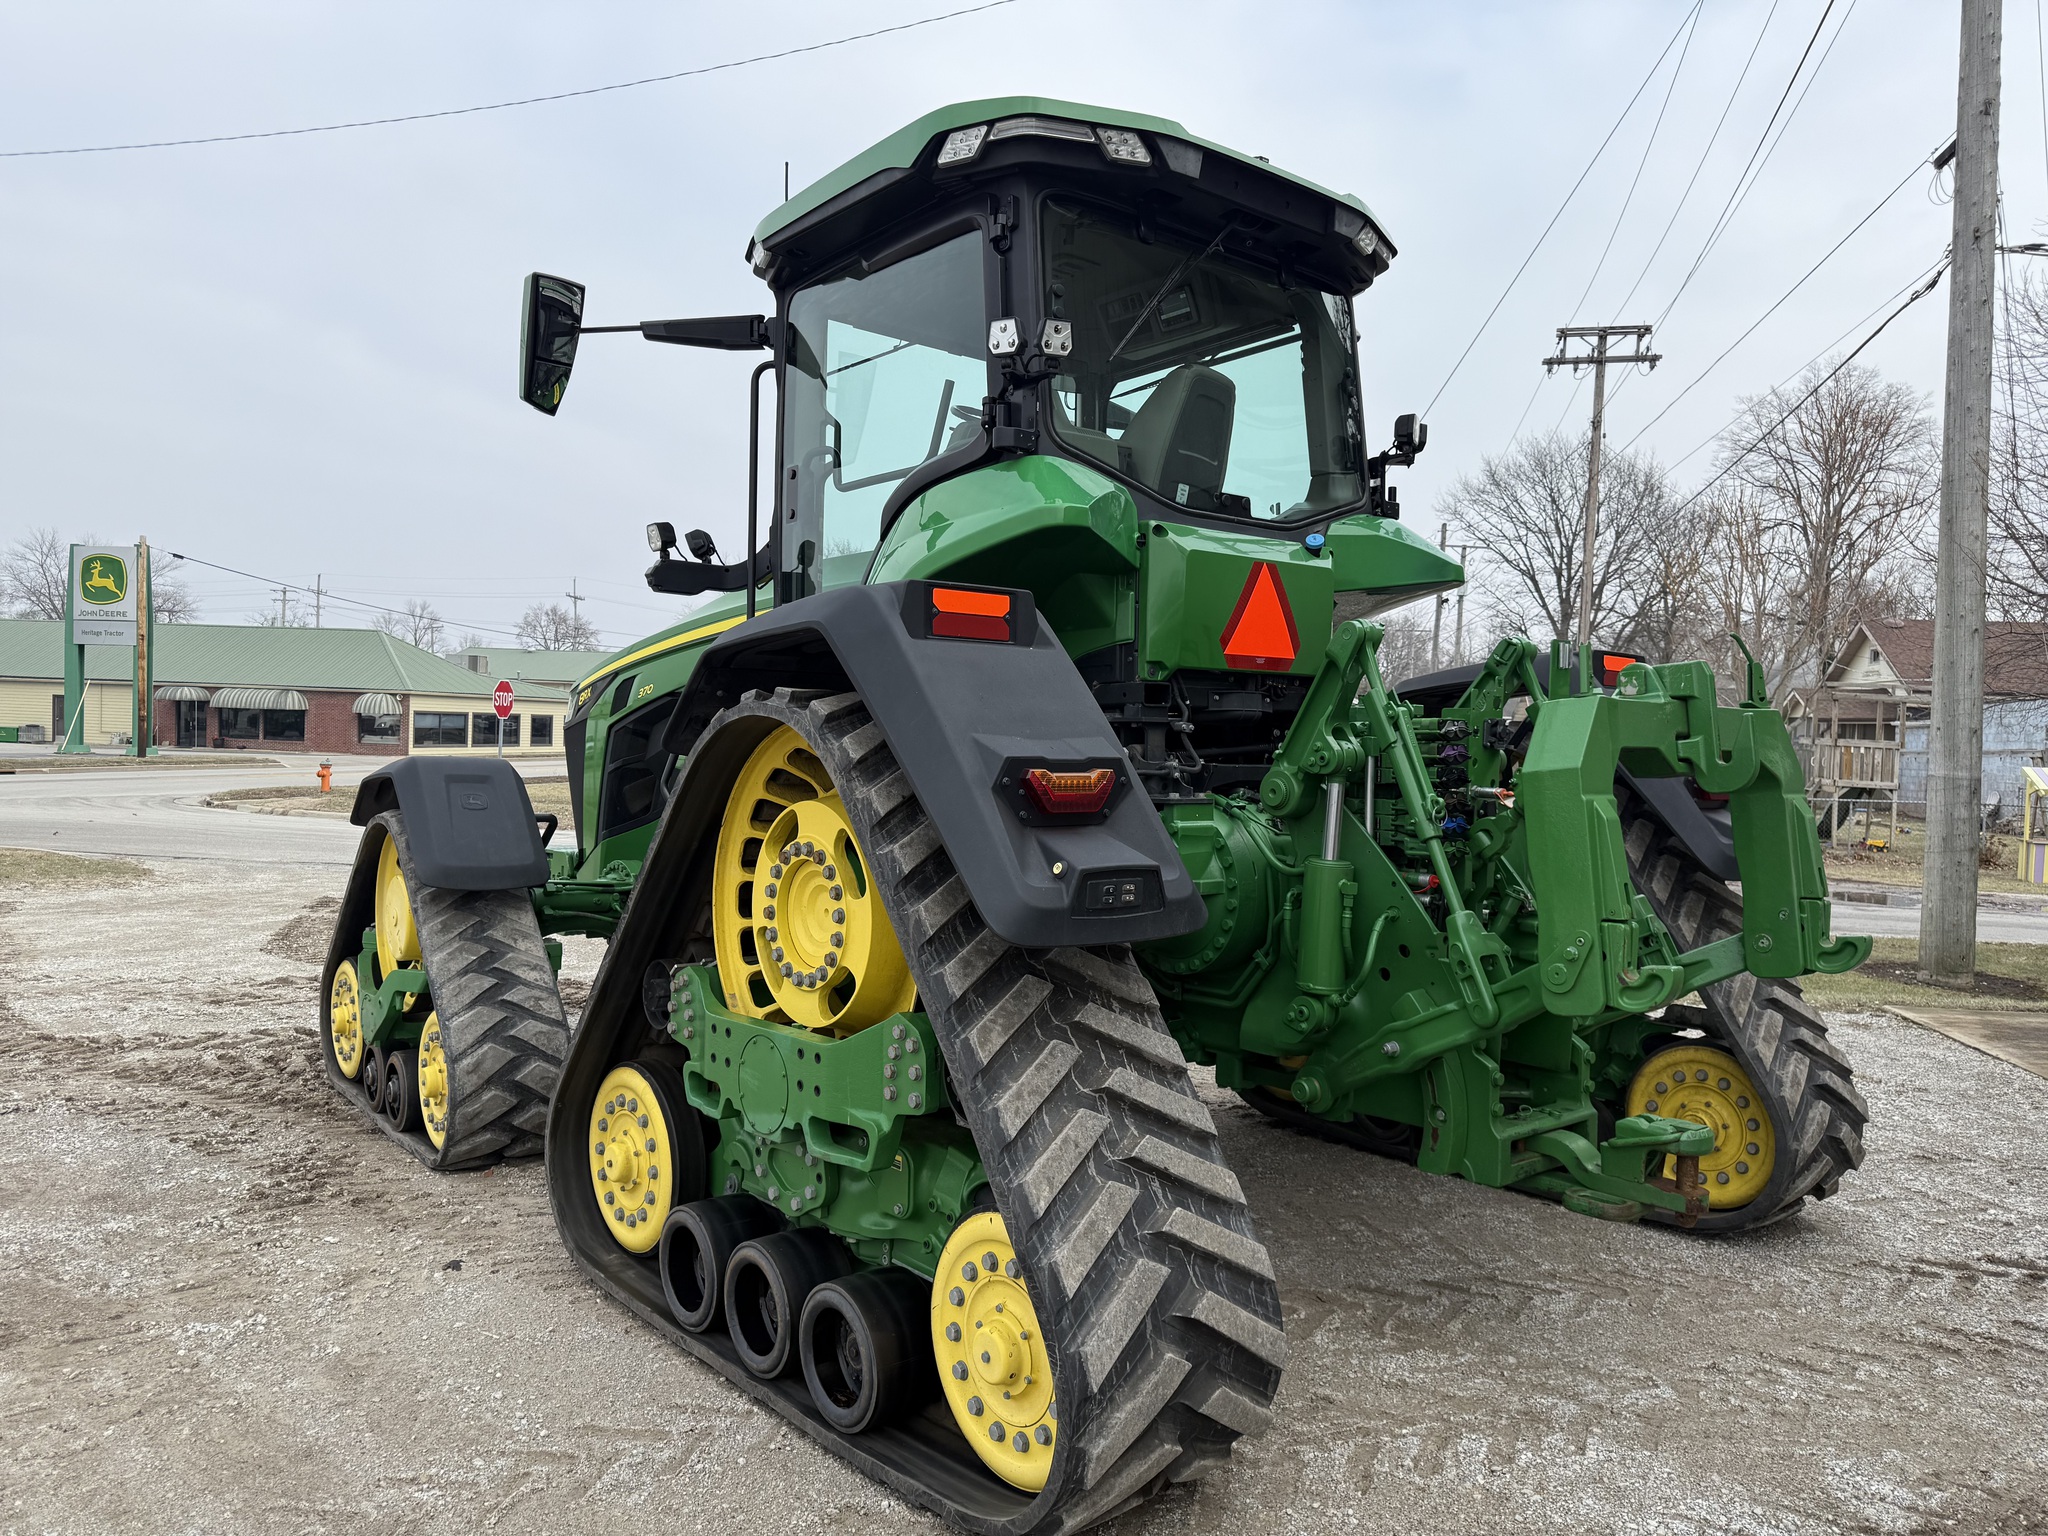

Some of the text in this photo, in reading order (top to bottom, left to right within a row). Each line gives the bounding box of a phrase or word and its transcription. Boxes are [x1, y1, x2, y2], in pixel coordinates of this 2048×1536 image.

[78, 609, 128, 618] JOHN DEERE
[494, 691, 513, 707] STOP
[637, 683, 654, 699] 370
